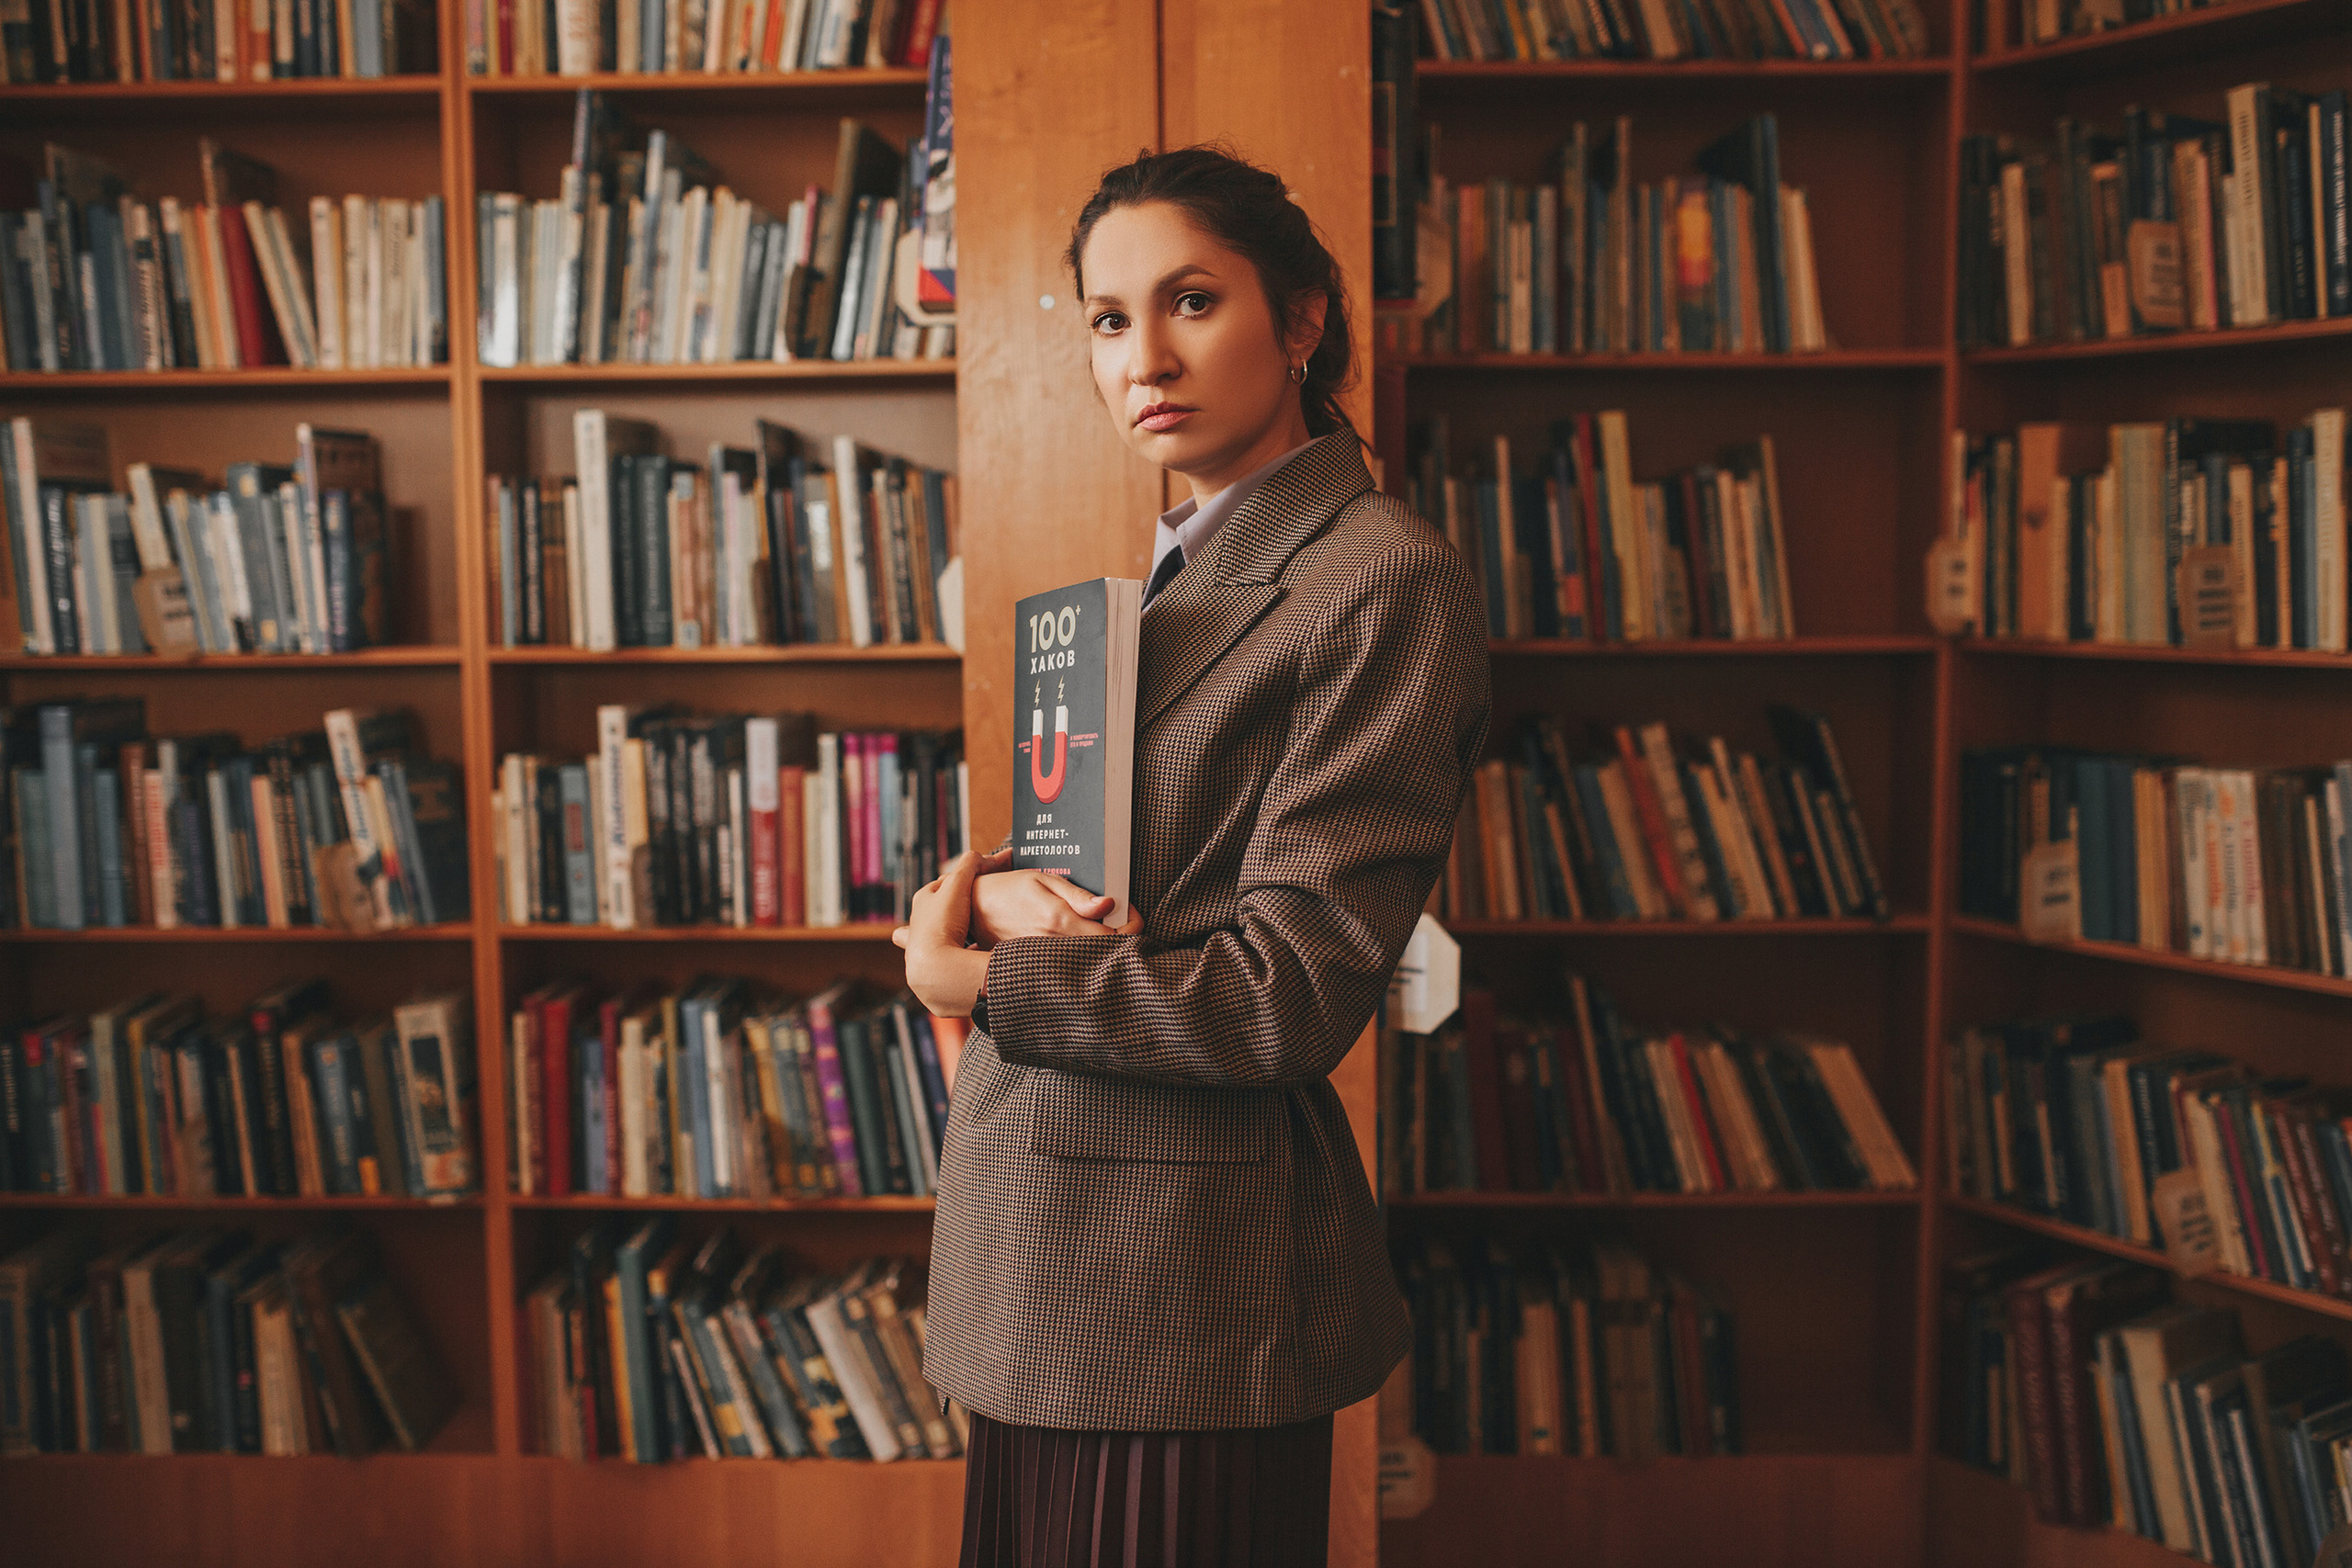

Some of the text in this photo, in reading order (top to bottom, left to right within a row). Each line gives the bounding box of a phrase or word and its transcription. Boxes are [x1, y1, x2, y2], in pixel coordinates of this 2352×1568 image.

[1029, 604, 1081, 653] 100+
[1030, 649, 1075, 674] ХАКОВ
[1036, 814, 1052, 825] ДЛЯ
[1026, 829, 1069, 840] ИНТЕРНЕТ-
[1020, 845, 1080, 856] МАРКЕТОЛОГОВ
